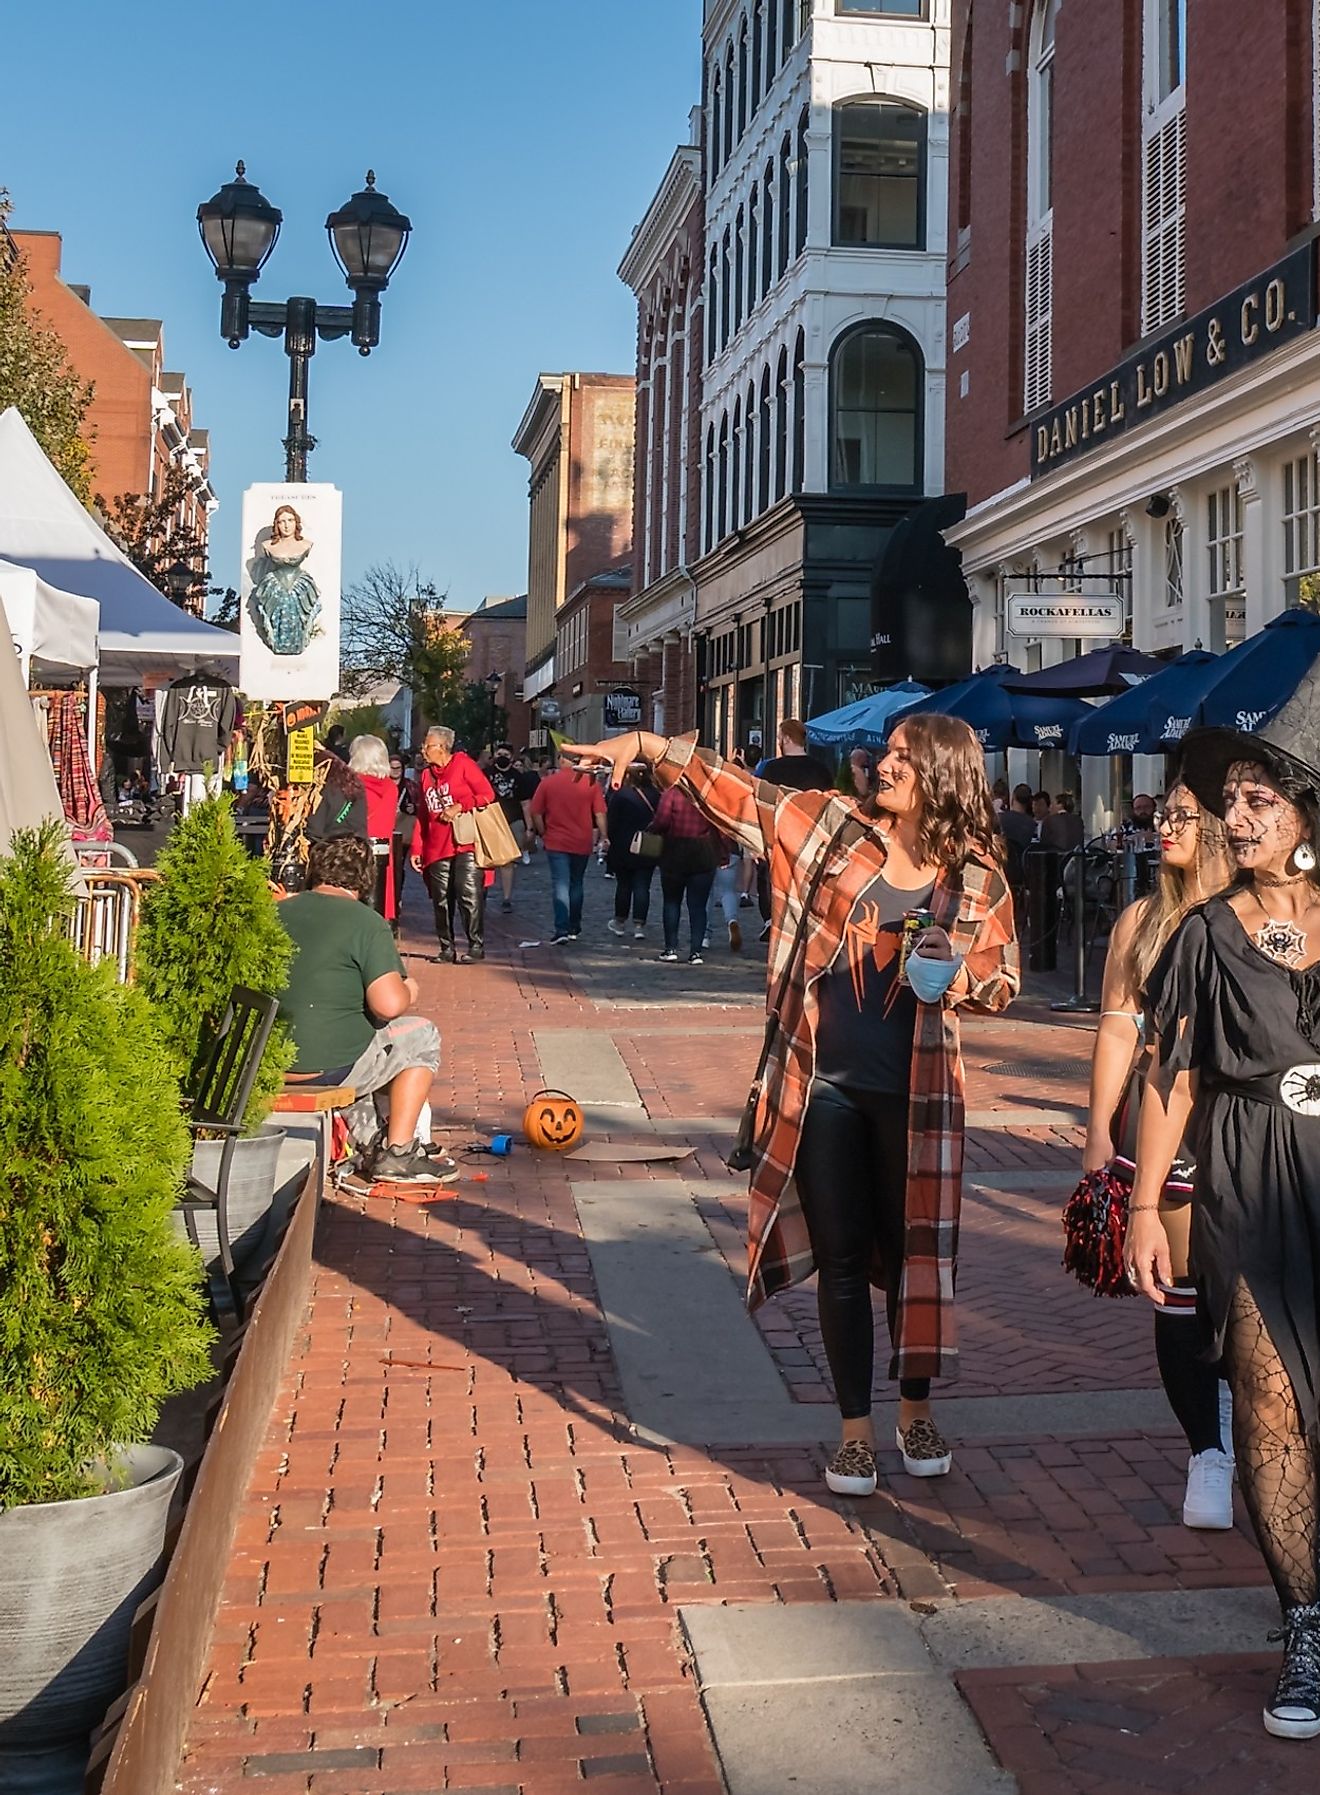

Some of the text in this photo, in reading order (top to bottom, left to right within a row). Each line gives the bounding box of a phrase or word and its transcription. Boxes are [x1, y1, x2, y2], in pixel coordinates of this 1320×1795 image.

[1037, 279, 1296, 463] DANIEL LOW & CO.
[1020, 607, 1112, 617] ROCKAFELLAS
[1107, 733, 1140, 743] SAMUEL
[1107, 740, 1134, 752] ADAMS
